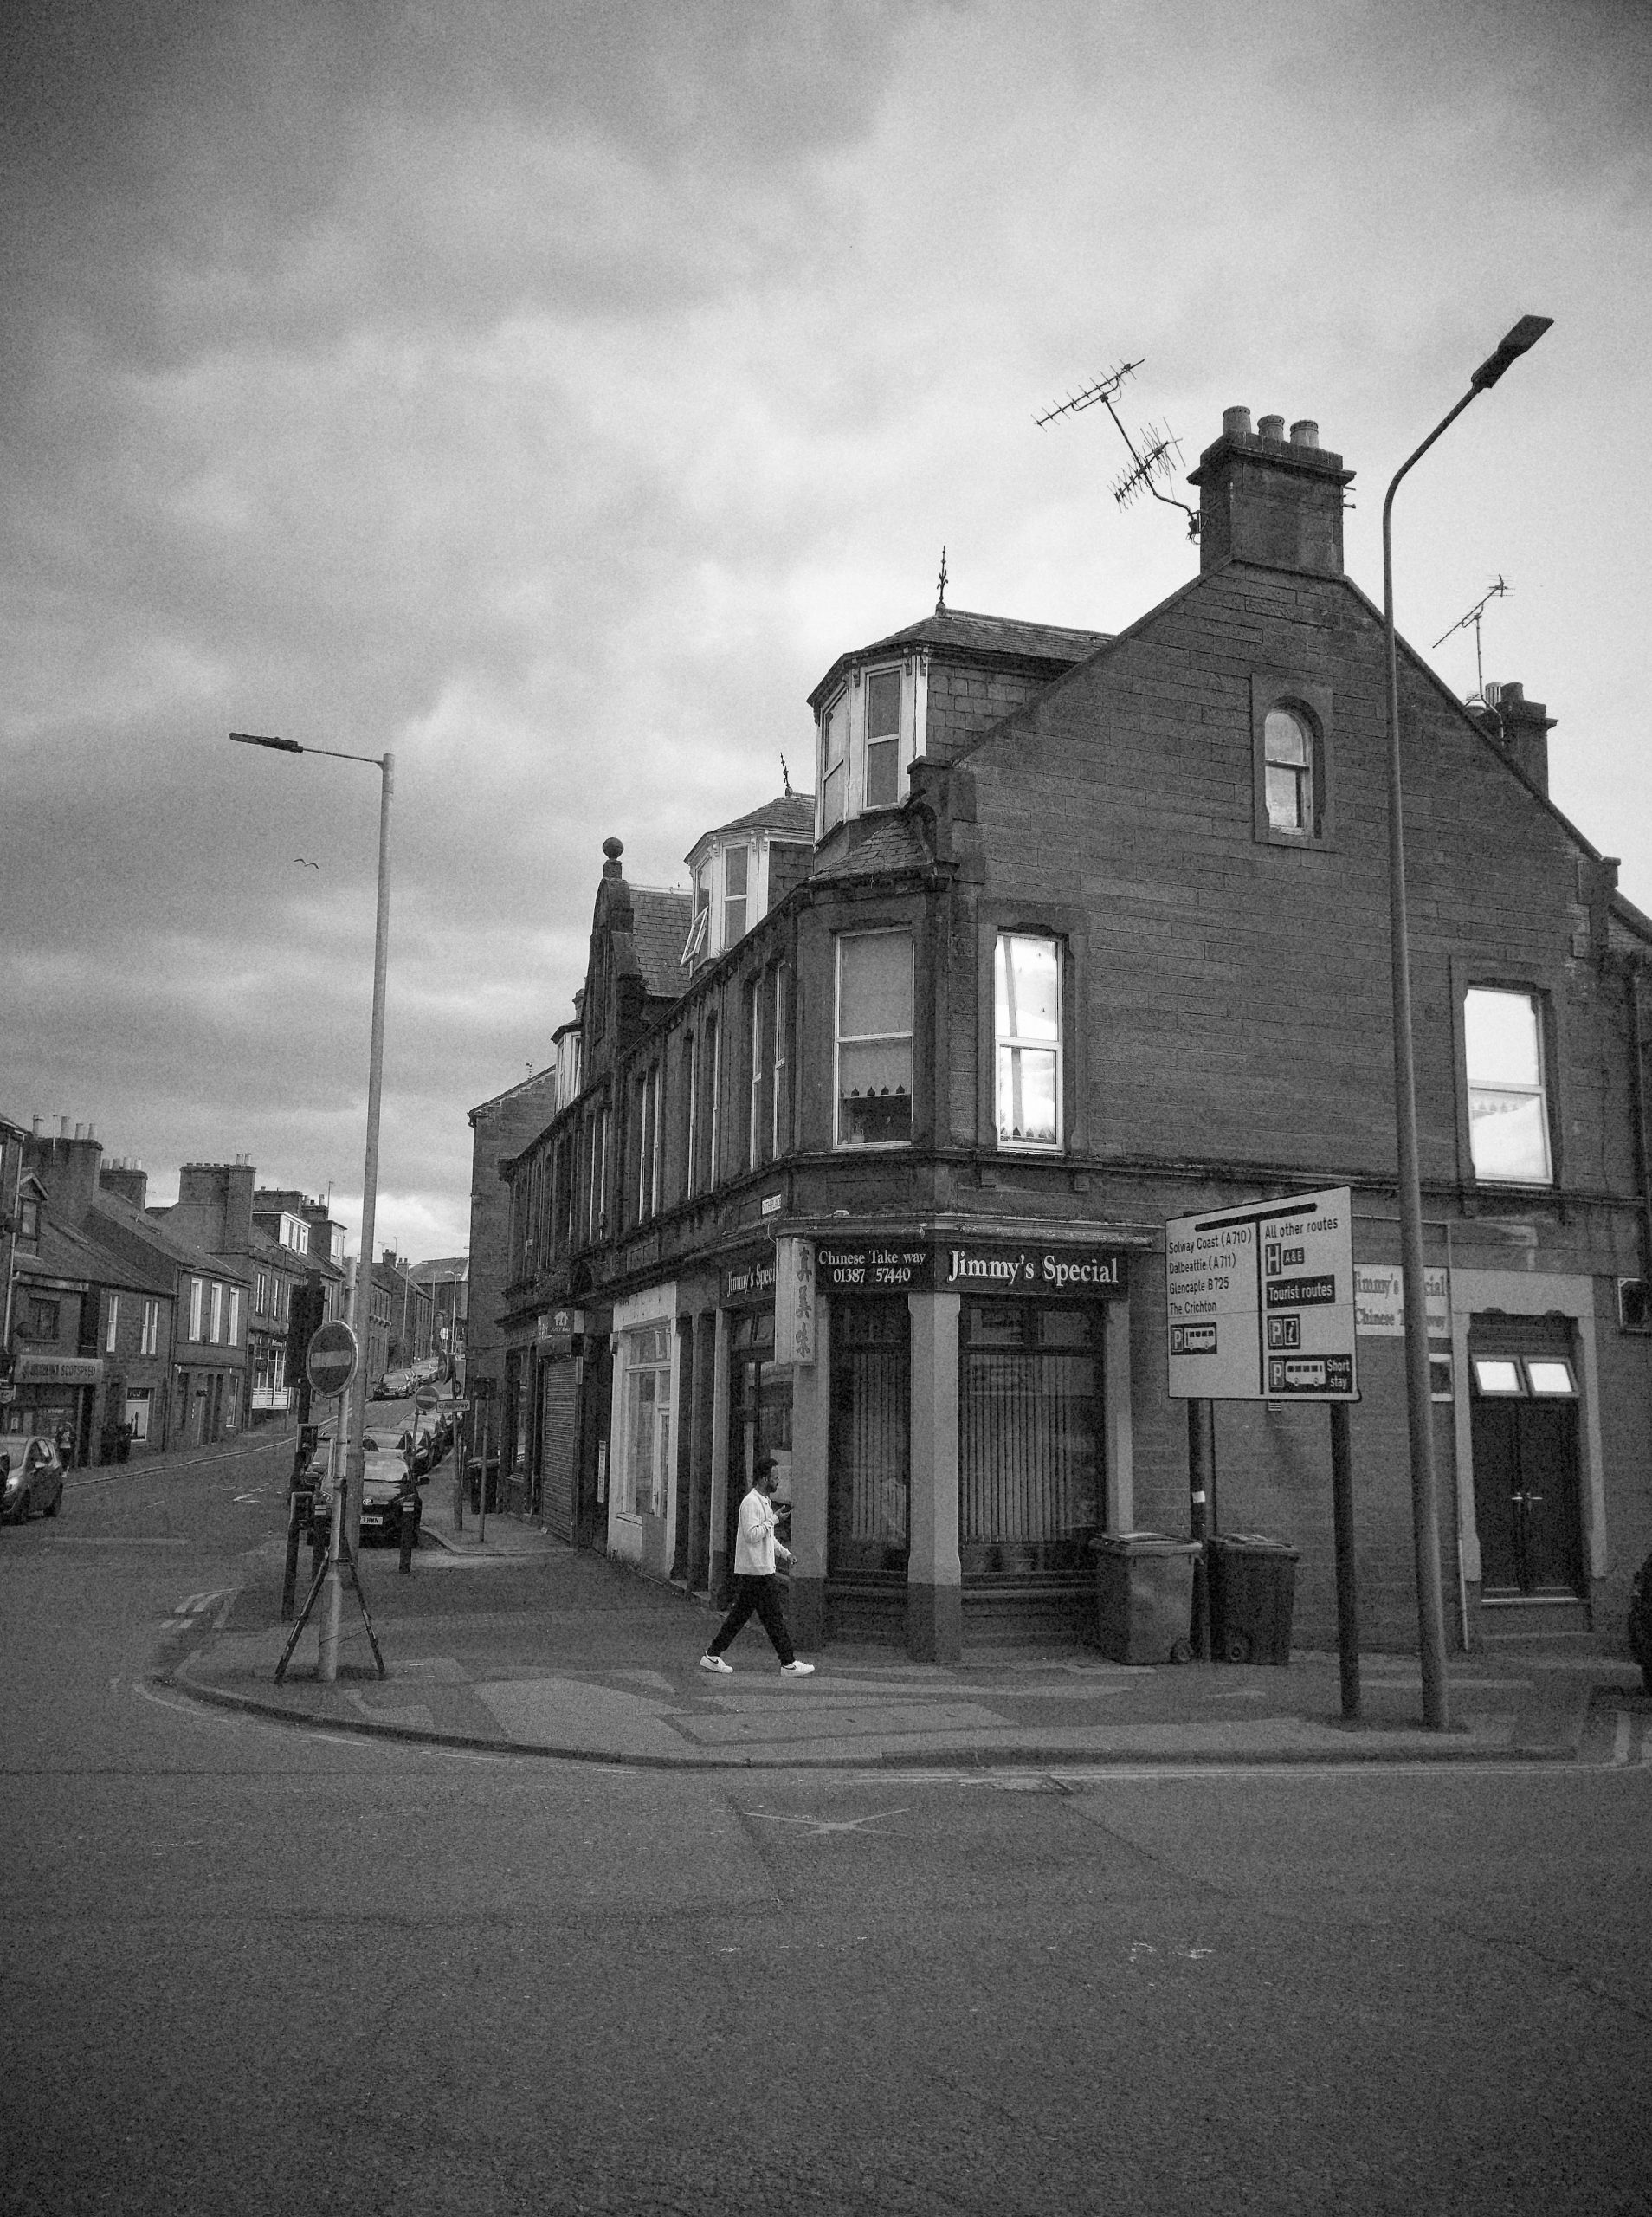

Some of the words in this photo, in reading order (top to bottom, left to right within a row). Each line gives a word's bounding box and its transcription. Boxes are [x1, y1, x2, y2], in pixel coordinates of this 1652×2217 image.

[1265, 1225, 1277, 1239] All
[1280, 1223, 1303, 1237] other
[1307, 1217, 1339, 1232] routes
[1169, 1241, 1194, 1254] Solway
[1197, 1235, 1218, 1250] Coast
[818, 1251, 866, 1264] Chinese
[868, 1250, 899, 1264] Take
[903, 1252, 926, 1265] way
[948, 1250, 1035, 1284] Jimmy's
[1042, 1255, 1120, 1287] Special
[1169, 1259, 1206, 1274] Dalbeattie
[727, 1266, 754, 1298] Jimmy's
[756, 1261, 776, 1290] Speci
[833, 1268, 866, 1283] 01387
[875, 1267, 911, 1283] 57440
[1169, 1280, 1205, 1295] Glencaple
[1268, 1285, 1300, 1301] Tourist
[1301, 1283, 1333, 1298] routes
[1170, 1302, 1183, 1315] The
[1184, 1301, 1217, 1314] Crichton
[1326, 1359, 1351, 1372] Short
[1330, 1375, 1347, 1390] stay
